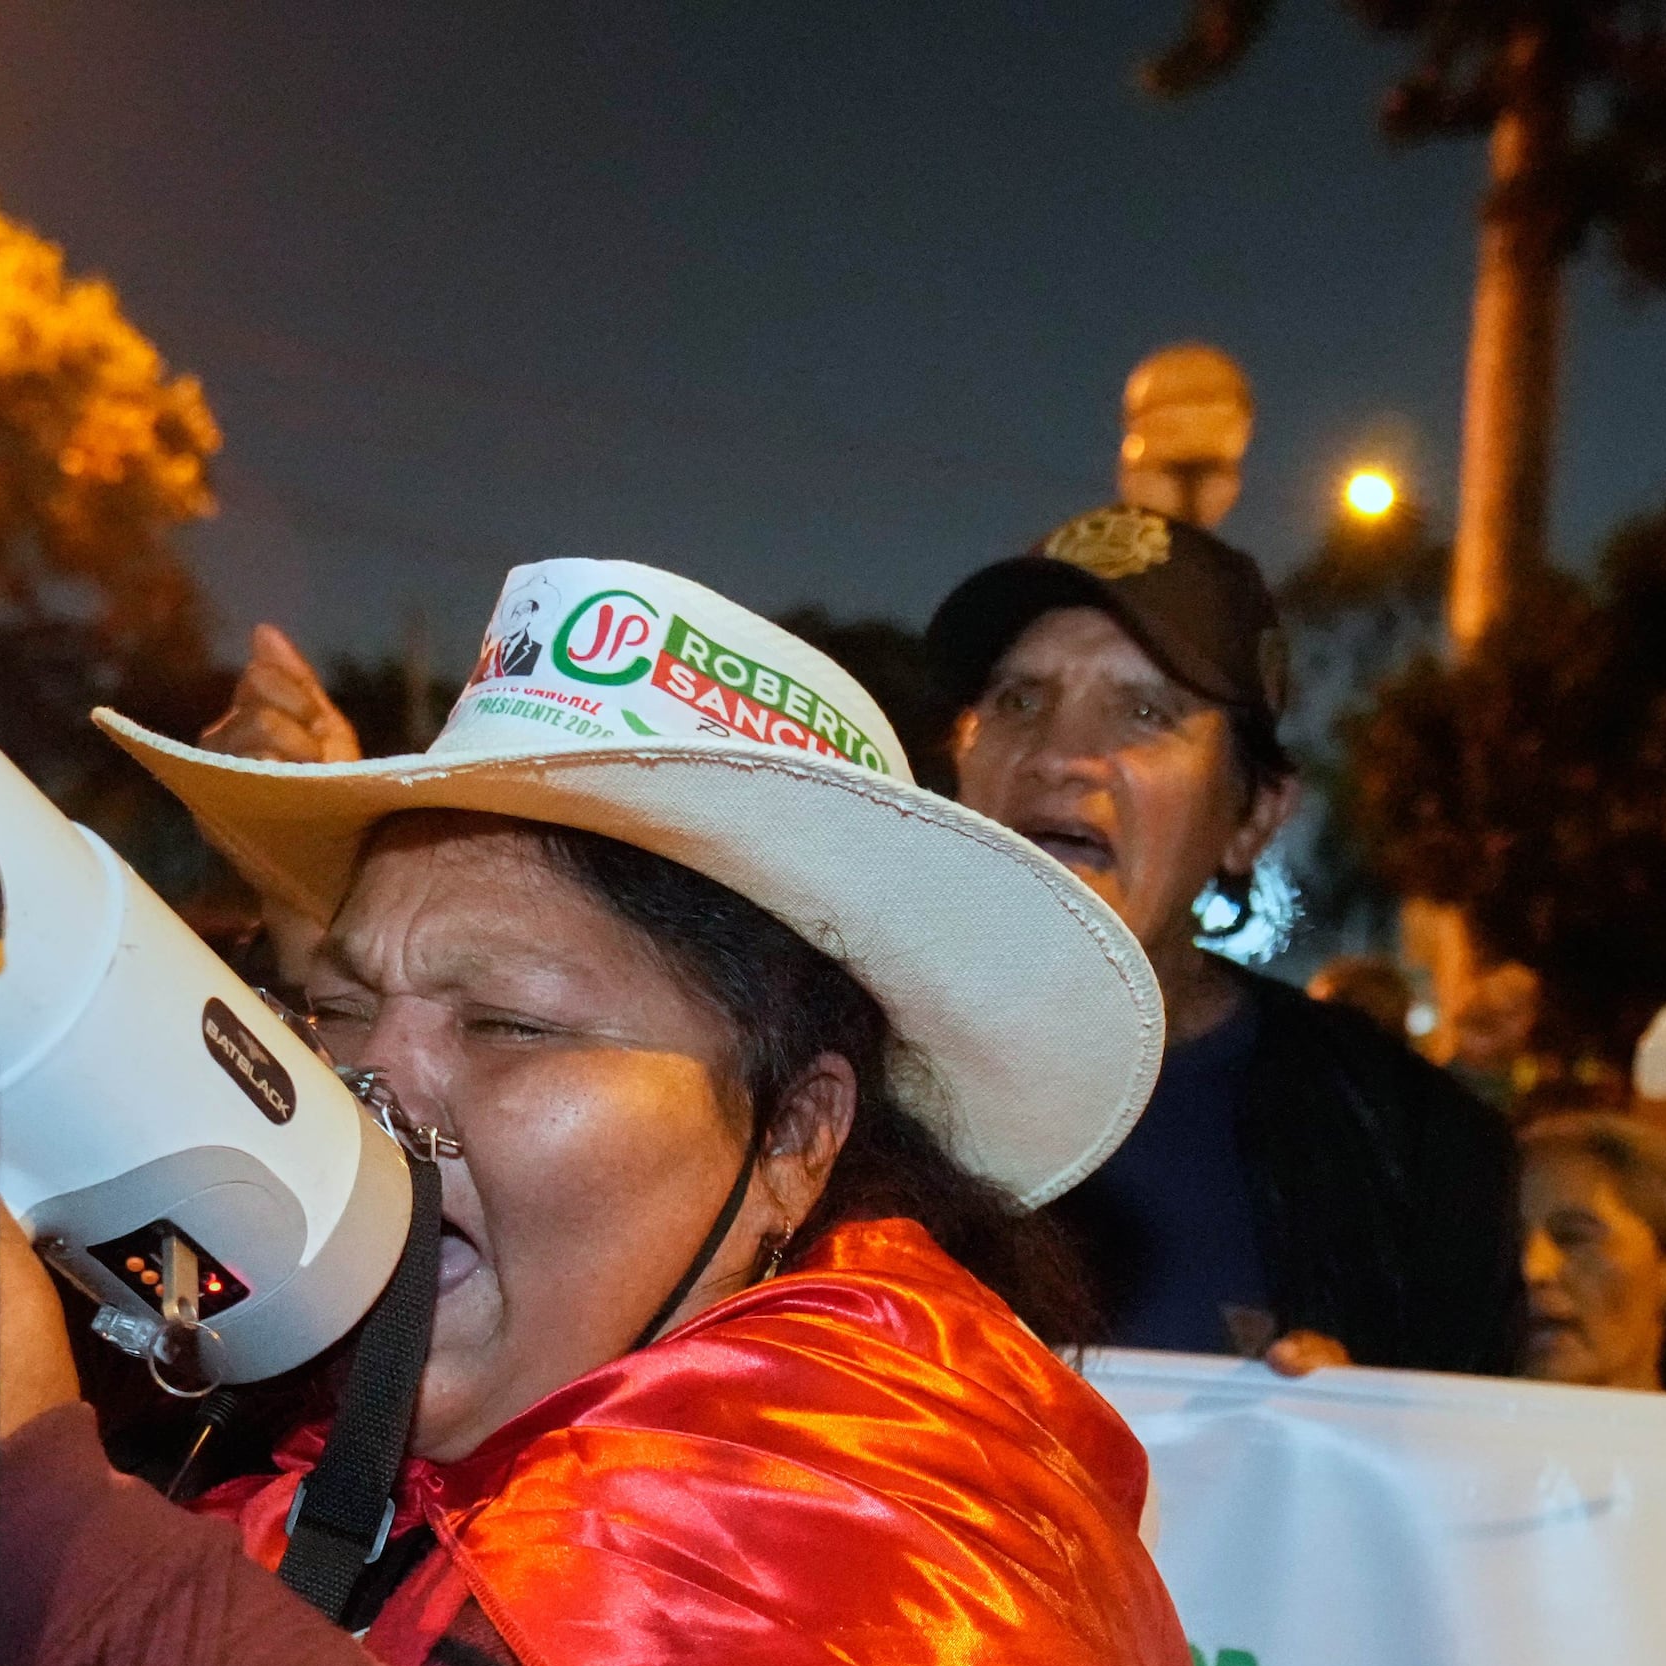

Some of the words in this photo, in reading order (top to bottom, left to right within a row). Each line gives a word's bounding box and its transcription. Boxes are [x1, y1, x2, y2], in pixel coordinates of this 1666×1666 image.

[474, 697, 565, 726] PRESIDENTE
[680, 630, 884, 775] ROBERTO
[204, 1017, 291, 1120] BATBLACK
